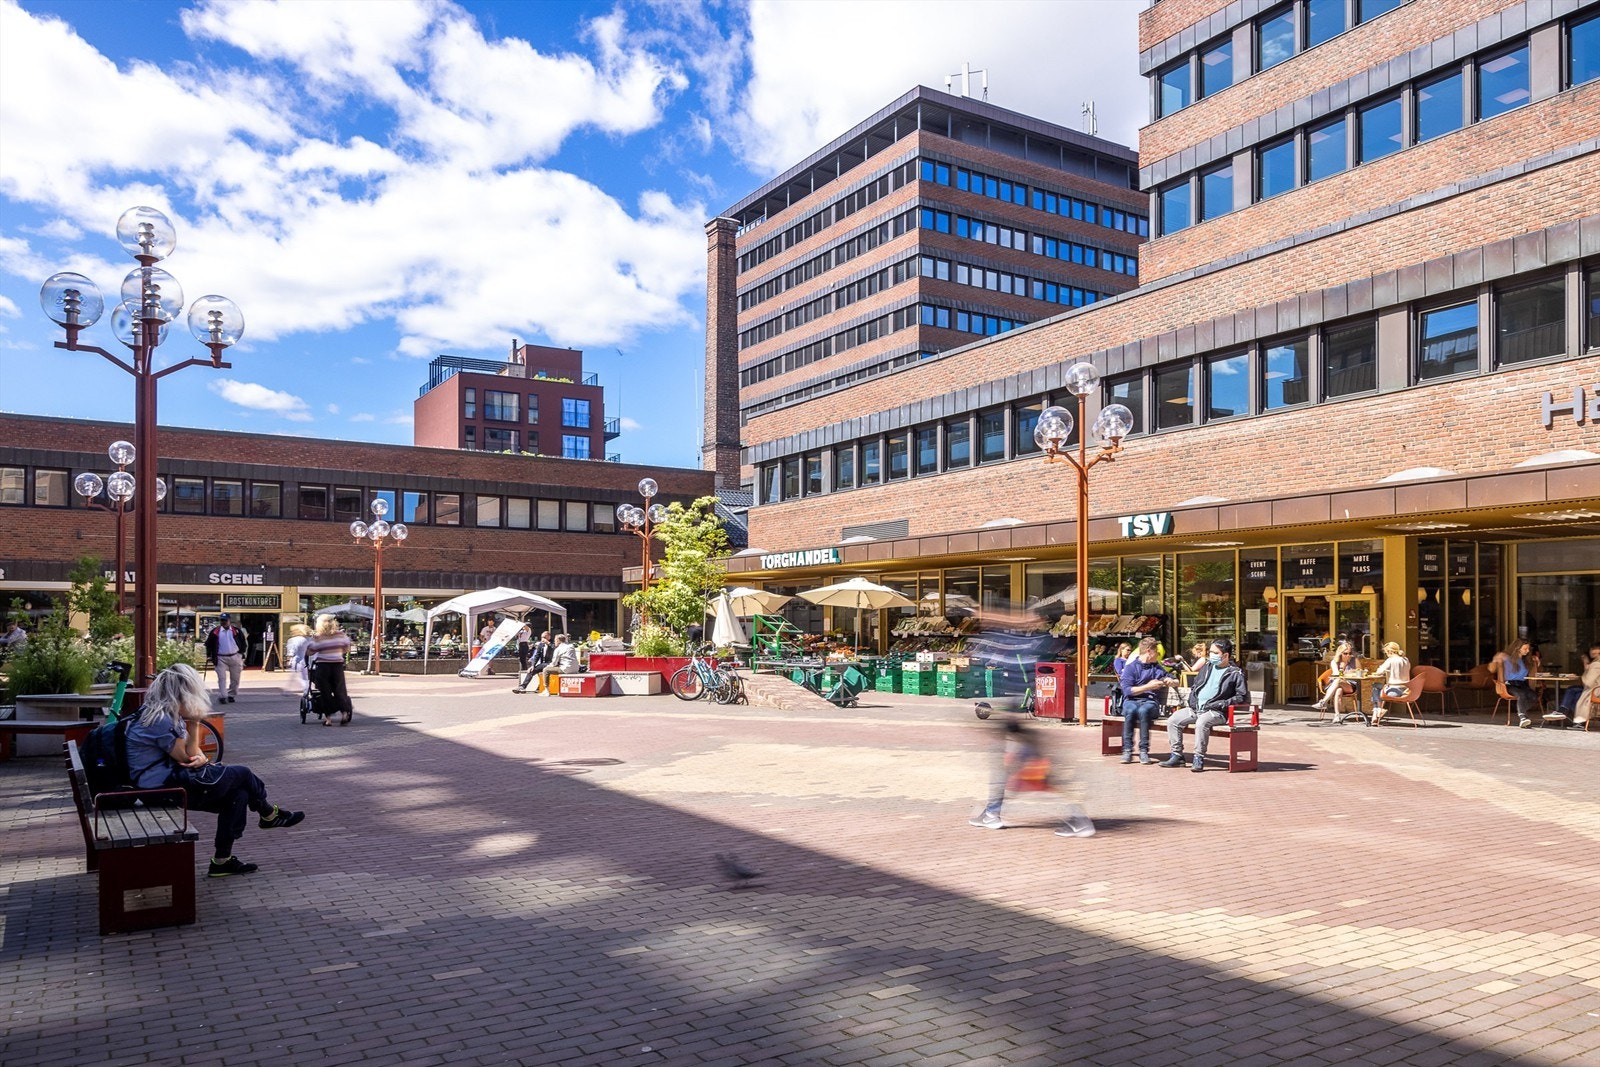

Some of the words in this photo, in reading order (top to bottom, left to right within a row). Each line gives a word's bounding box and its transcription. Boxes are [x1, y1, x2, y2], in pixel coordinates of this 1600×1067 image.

[1117, 512, 1169, 537] TSV
[760, 548, 839, 569] TORGHANDEL
[1302, 568, 1313, 576] BAR
[1352, 565, 1371, 573] PLASS
[208, 572, 263, 585] SCENE
